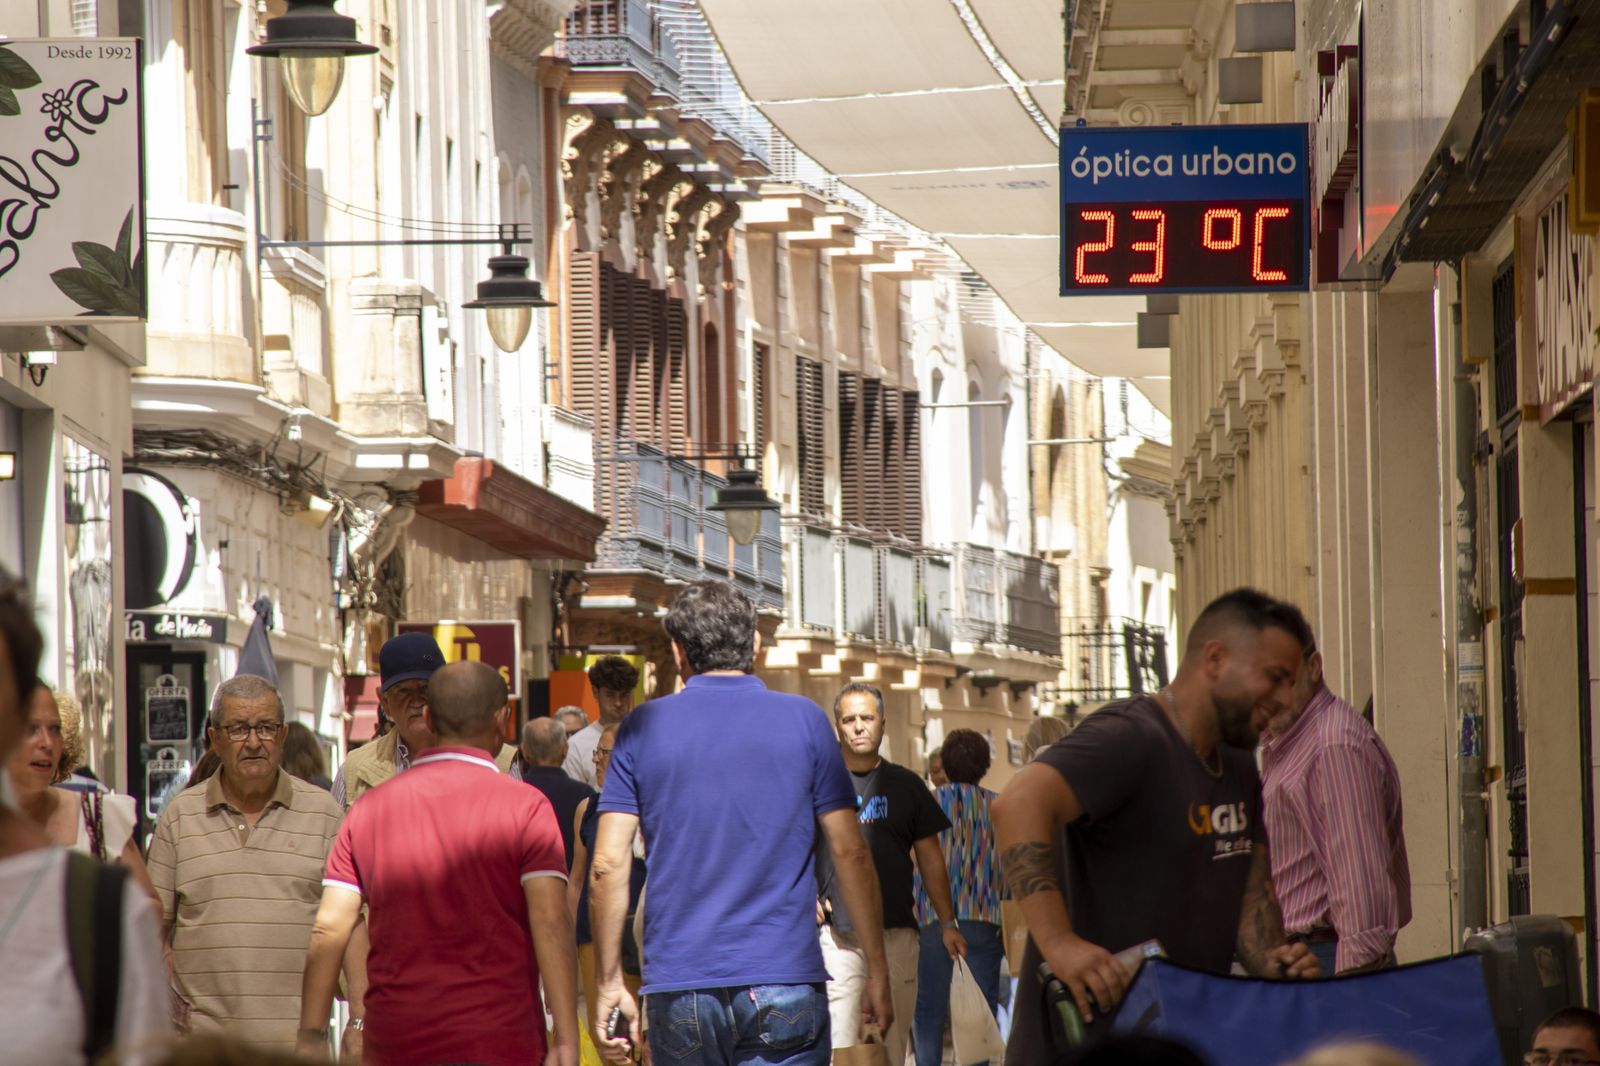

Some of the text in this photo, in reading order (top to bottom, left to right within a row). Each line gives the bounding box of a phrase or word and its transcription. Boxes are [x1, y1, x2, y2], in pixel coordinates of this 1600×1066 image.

[47, 45, 133, 60] Desde 1992
[1070, 145, 1297, 185] óptica urbano
[1075, 209, 1166, 284] 23
[147, 686, 187, 697] OFERTA
